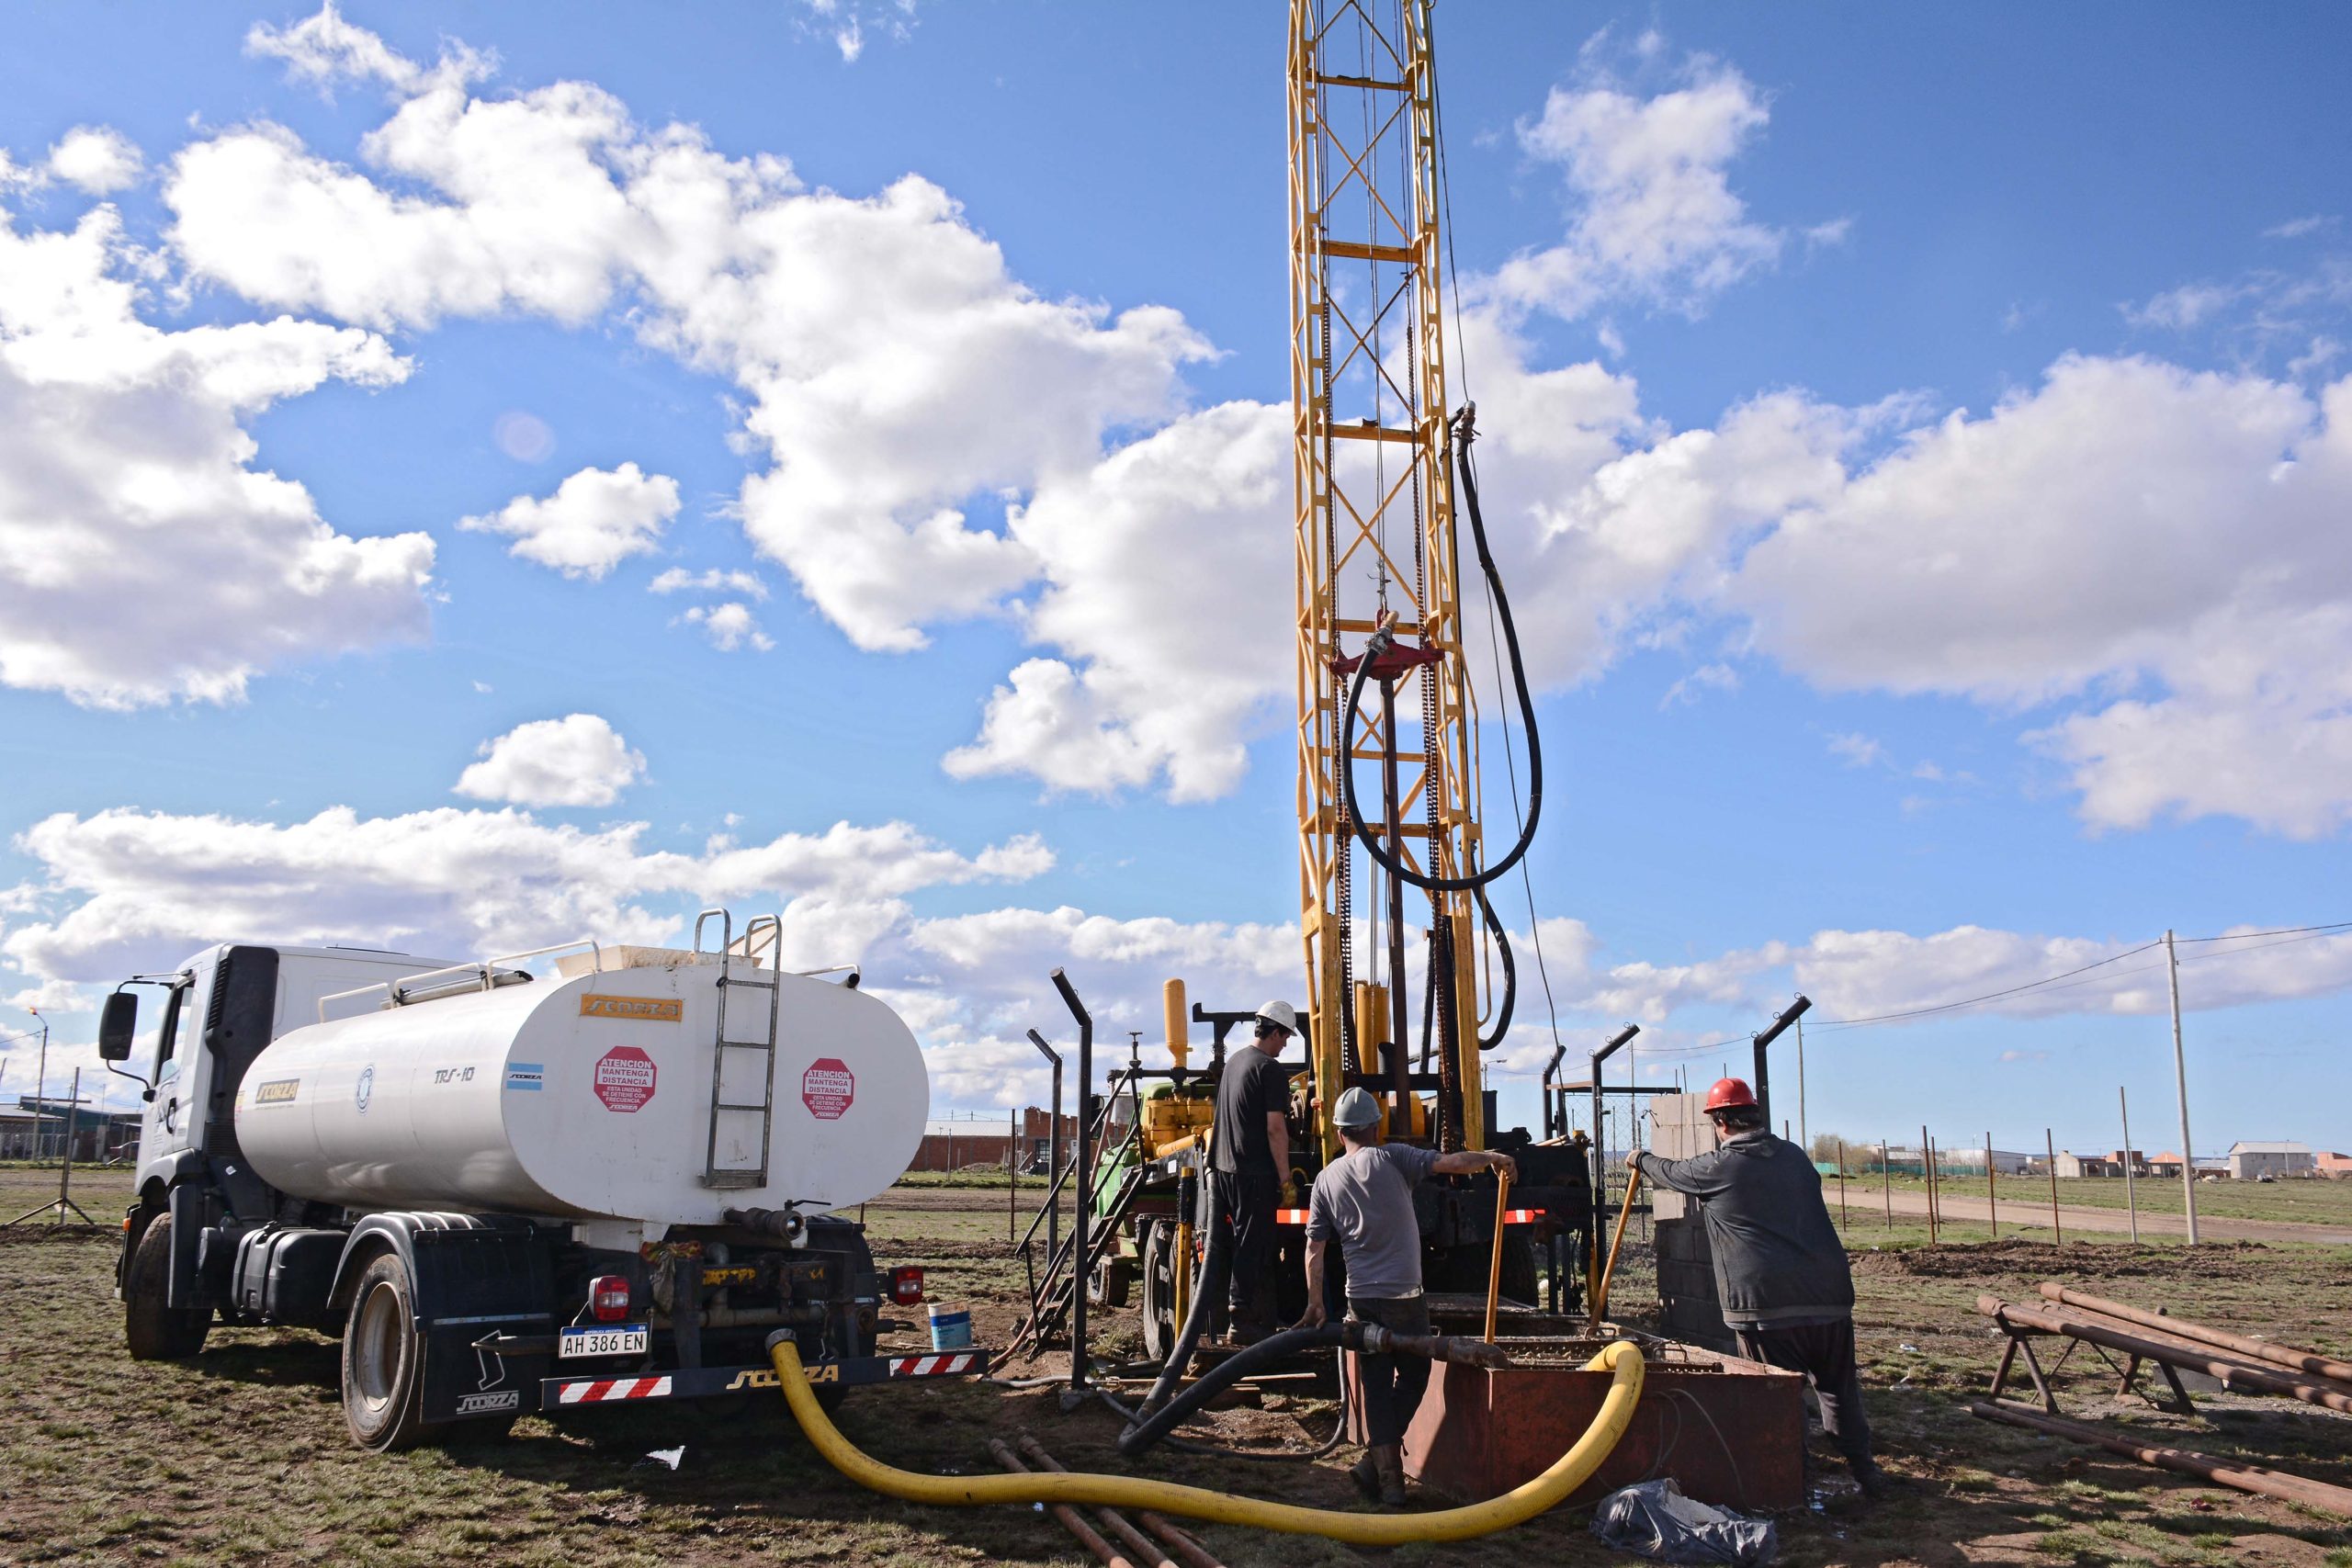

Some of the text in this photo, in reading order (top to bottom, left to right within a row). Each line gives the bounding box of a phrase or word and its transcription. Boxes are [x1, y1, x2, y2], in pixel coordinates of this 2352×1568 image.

[601, 1058, 652, 1069] ATENCION
[602, 1068, 649, 1077] MANTENGA
[808, 1070, 849, 1079] ATENCION
[602, 1077, 647, 1085] DISTANCIA
[257, 1082, 299, 1101] SCORZA
[565, 1334, 643, 1354] AH 386 EN
[456, 1393, 519, 1412] SCORZA
